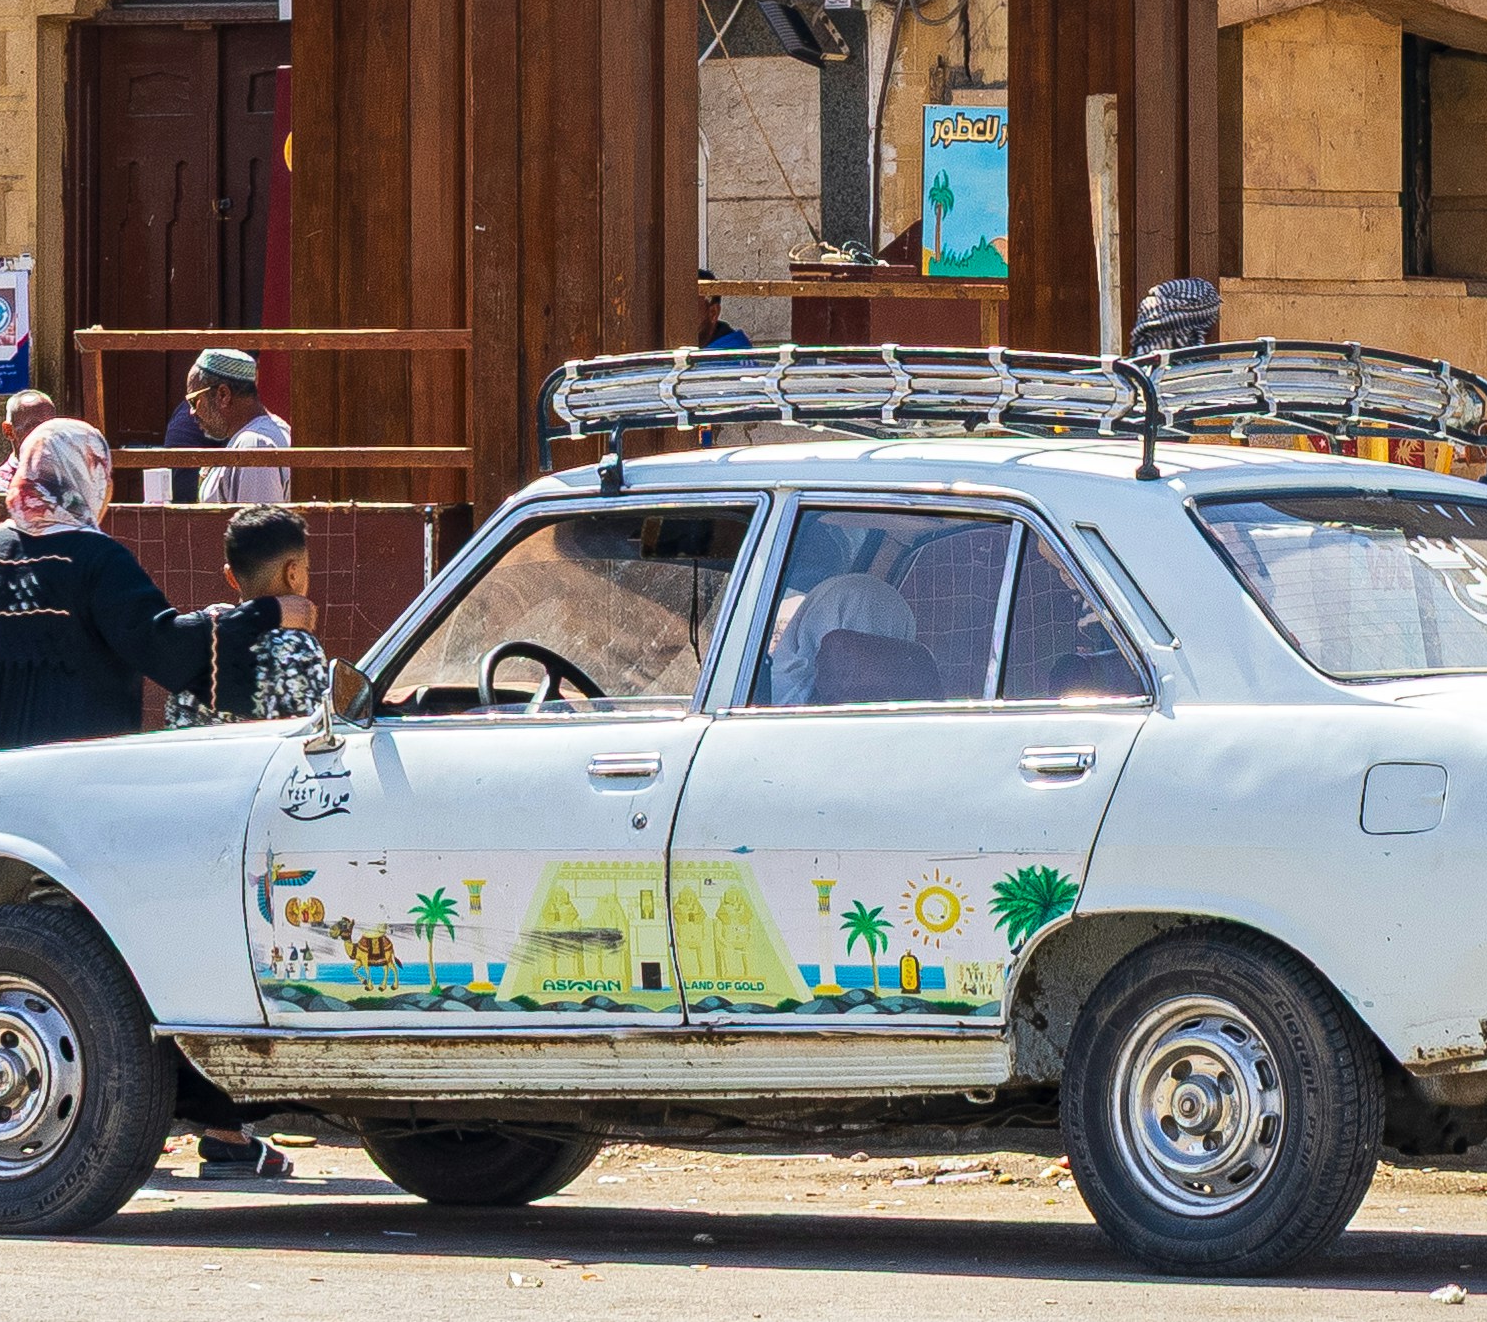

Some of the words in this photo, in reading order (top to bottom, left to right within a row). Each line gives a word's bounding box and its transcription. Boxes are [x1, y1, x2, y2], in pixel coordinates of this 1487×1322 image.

[542, 979, 622, 992] ASWAN
[684, 981, 714, 991] LAND
[717, 981, 732, 991] OF
[734, 981, 764, 991] GOLD
